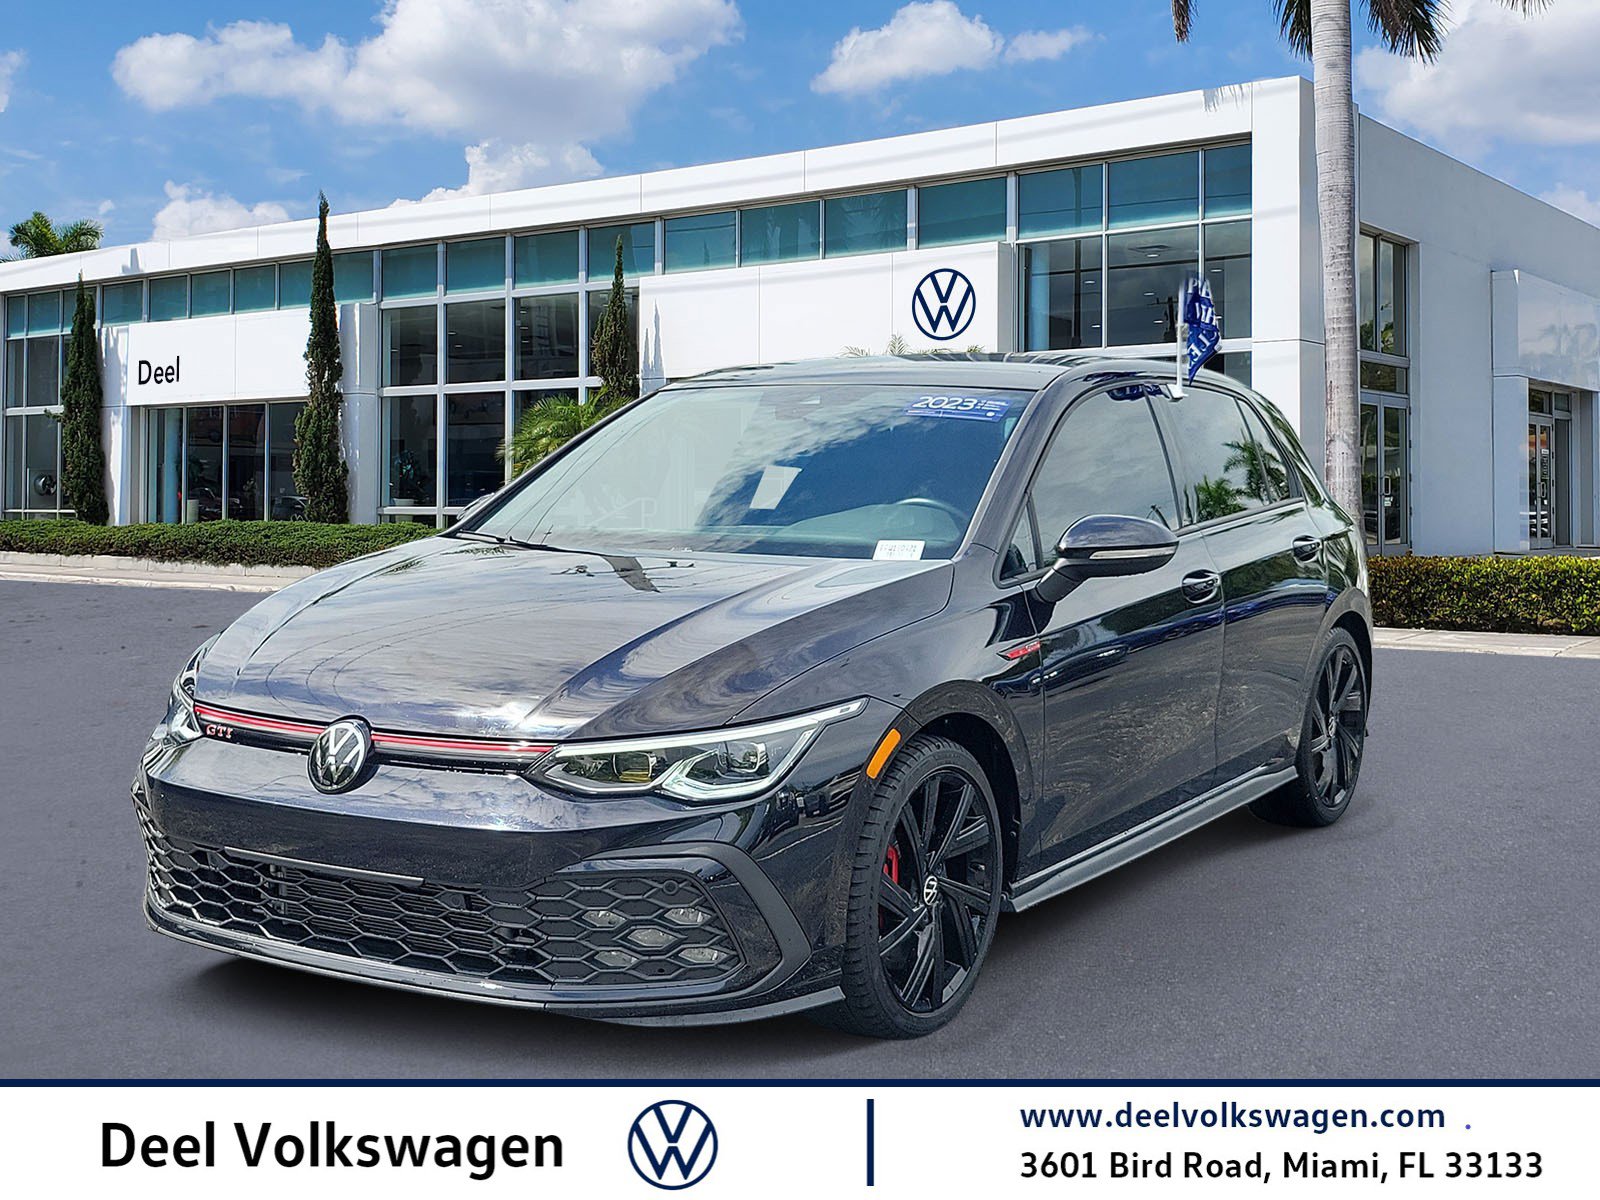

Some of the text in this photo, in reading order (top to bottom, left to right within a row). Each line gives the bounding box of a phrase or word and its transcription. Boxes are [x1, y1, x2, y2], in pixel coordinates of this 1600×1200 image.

[137, 355, 180, 386] Deel
[912, 396, 977, 410] 2023
[205, 723, 234, 740] GTI
